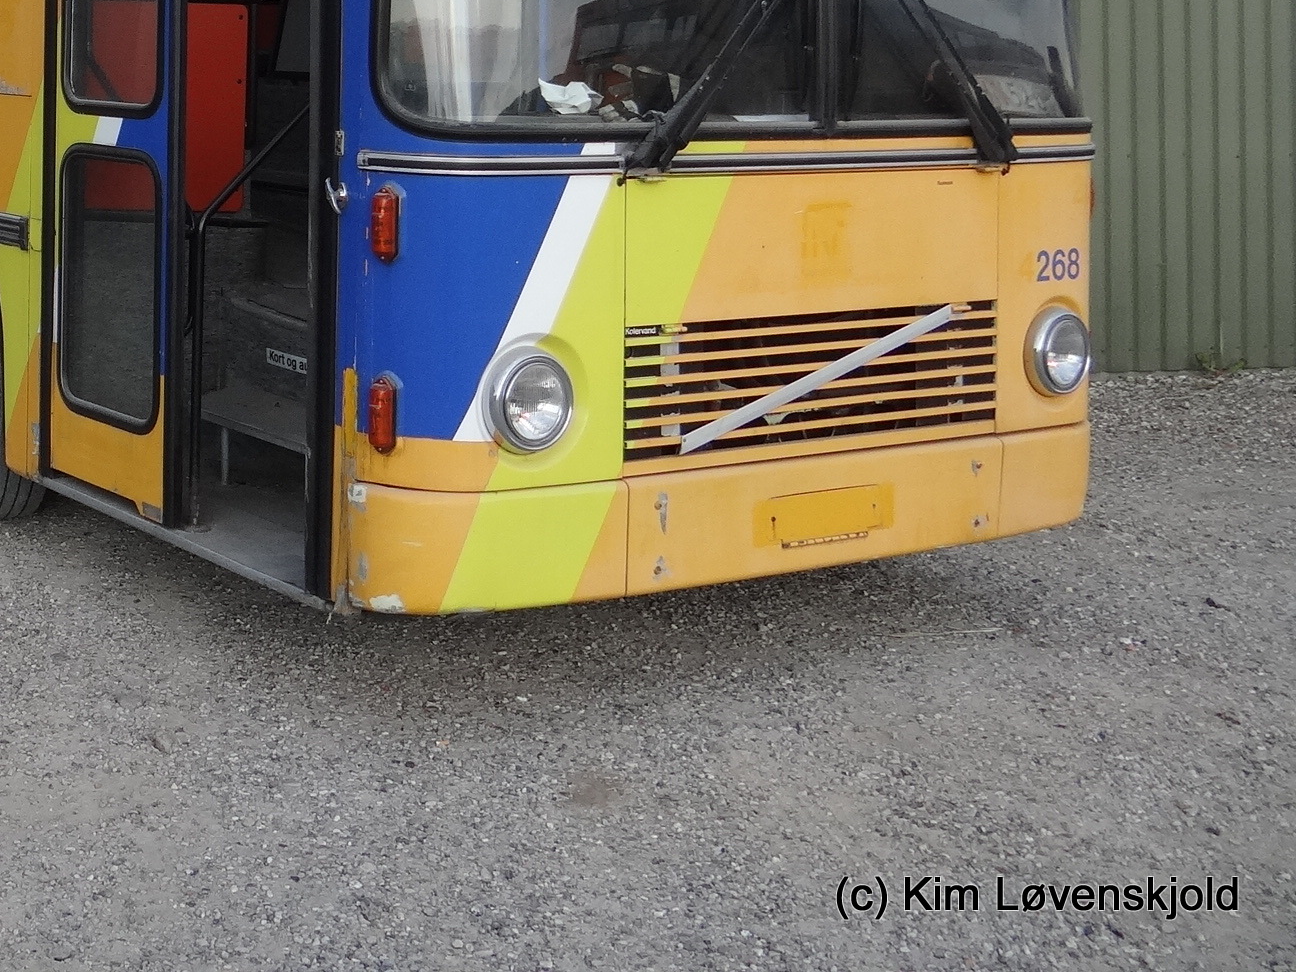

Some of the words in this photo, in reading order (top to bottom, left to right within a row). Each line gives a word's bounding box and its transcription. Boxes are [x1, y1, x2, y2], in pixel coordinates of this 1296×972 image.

[1036, 247, 1080, 282] 268
[269, 350, 285, 366] Kort
[286, 357, 297, 371] og
